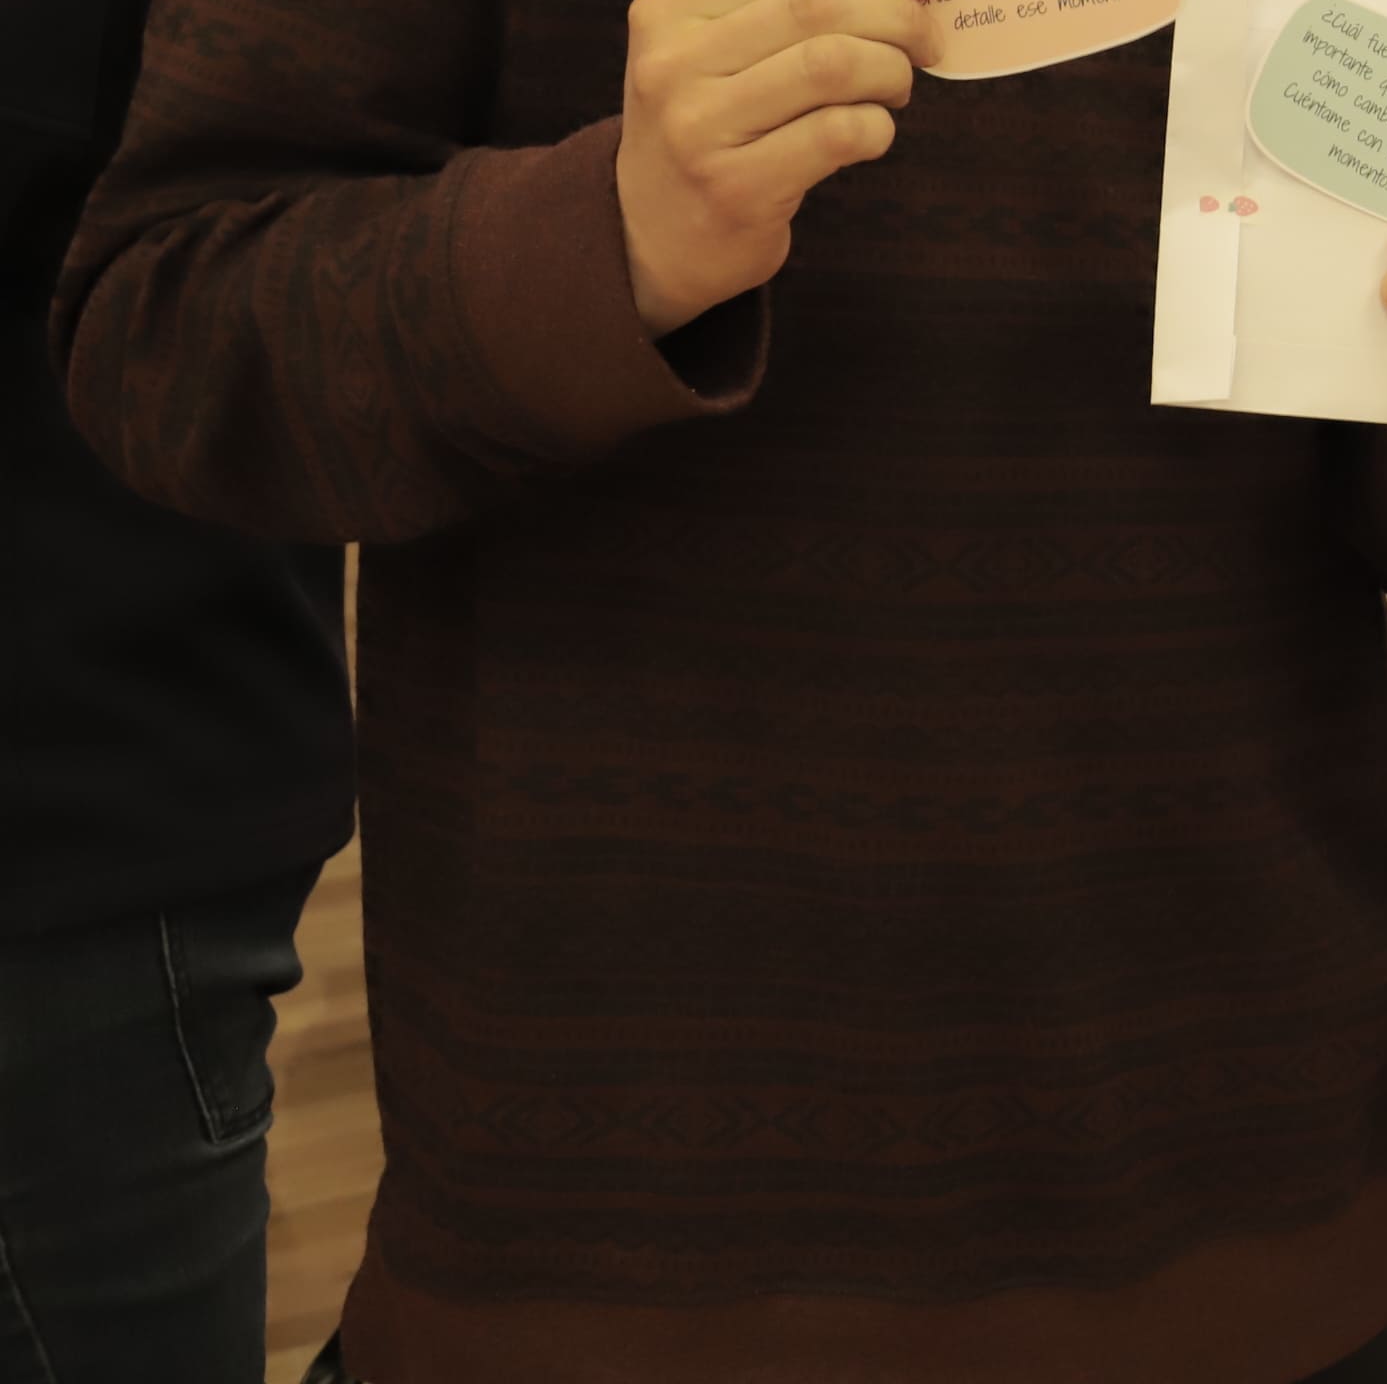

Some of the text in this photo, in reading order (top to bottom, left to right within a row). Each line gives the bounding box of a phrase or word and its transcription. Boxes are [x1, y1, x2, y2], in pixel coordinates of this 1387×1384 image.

[953, 5, 1006, 31] detalle
[1017, 0, 1047, 19] ese
[1303, 28, 1374, 81] importante
[1312, 68, 1349, 97] cómo
[1283, 82, 1350, 133] Cuéntame
[1357, 129, 1383, 152] con
